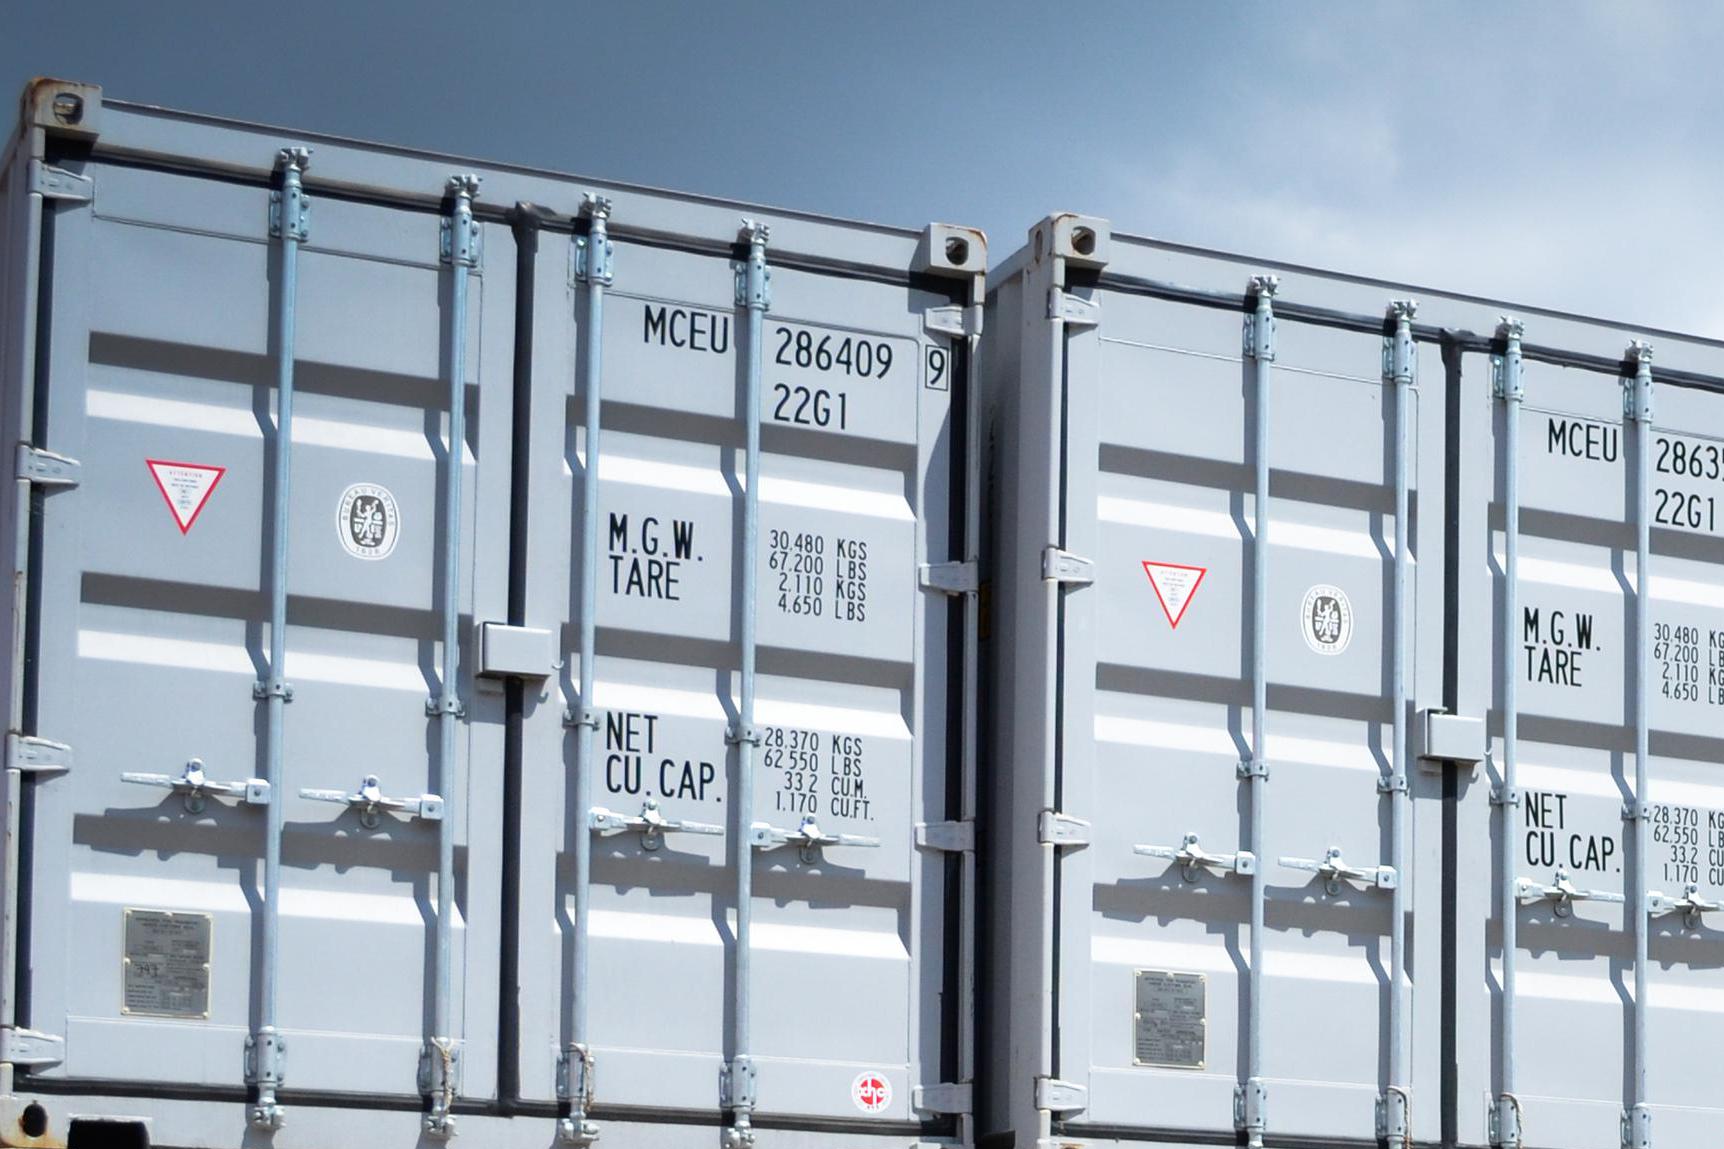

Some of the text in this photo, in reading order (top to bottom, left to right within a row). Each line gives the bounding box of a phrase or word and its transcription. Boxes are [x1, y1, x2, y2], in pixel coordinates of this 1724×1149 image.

[644, 305, 945, 385] MCEU 286409 9
[774, 383, 846, 430] 22G1
[1548, 418, 1617, 462] MCEU
[1655, 489, 1714, 531] 22G1
[610, 512, 703, 561] M.G.W.
[770, 530, 867, 560] 30.480 KGS
[610, 555, 680, 600] TARE
[770, 551, 866, 581] 67.200 LBS
[779, 572, 865, 601] 2.110 KGS
[778, 593, 865, 621] 4.650 LBS
[1524, 606, 1600, 651] M.G.W.
[1654, 623, 1698, 645] 30.480
[1524, 646, 1582, 687] TARE
[1654, 642, 1698, 664] 67.200
[1662, 661, 1698, 683] 2.110
[1662, 681, 1698, 701] 4.650
[607, 711, 658, 753] NET
[765, 727, 862, 756] 28.370 KGS
[832, 755, 861, 777] LBS
[777, 791, 816, 813] 1.170
[1525, 791, 1567, 830] NET
[1654, 805, 1698, 826] 28.370
[1654, 825, 1698, 845] 62.550
[1670, 845, 1698, 865] 33.2
[1664, 863, 1698, 883] 1.170
